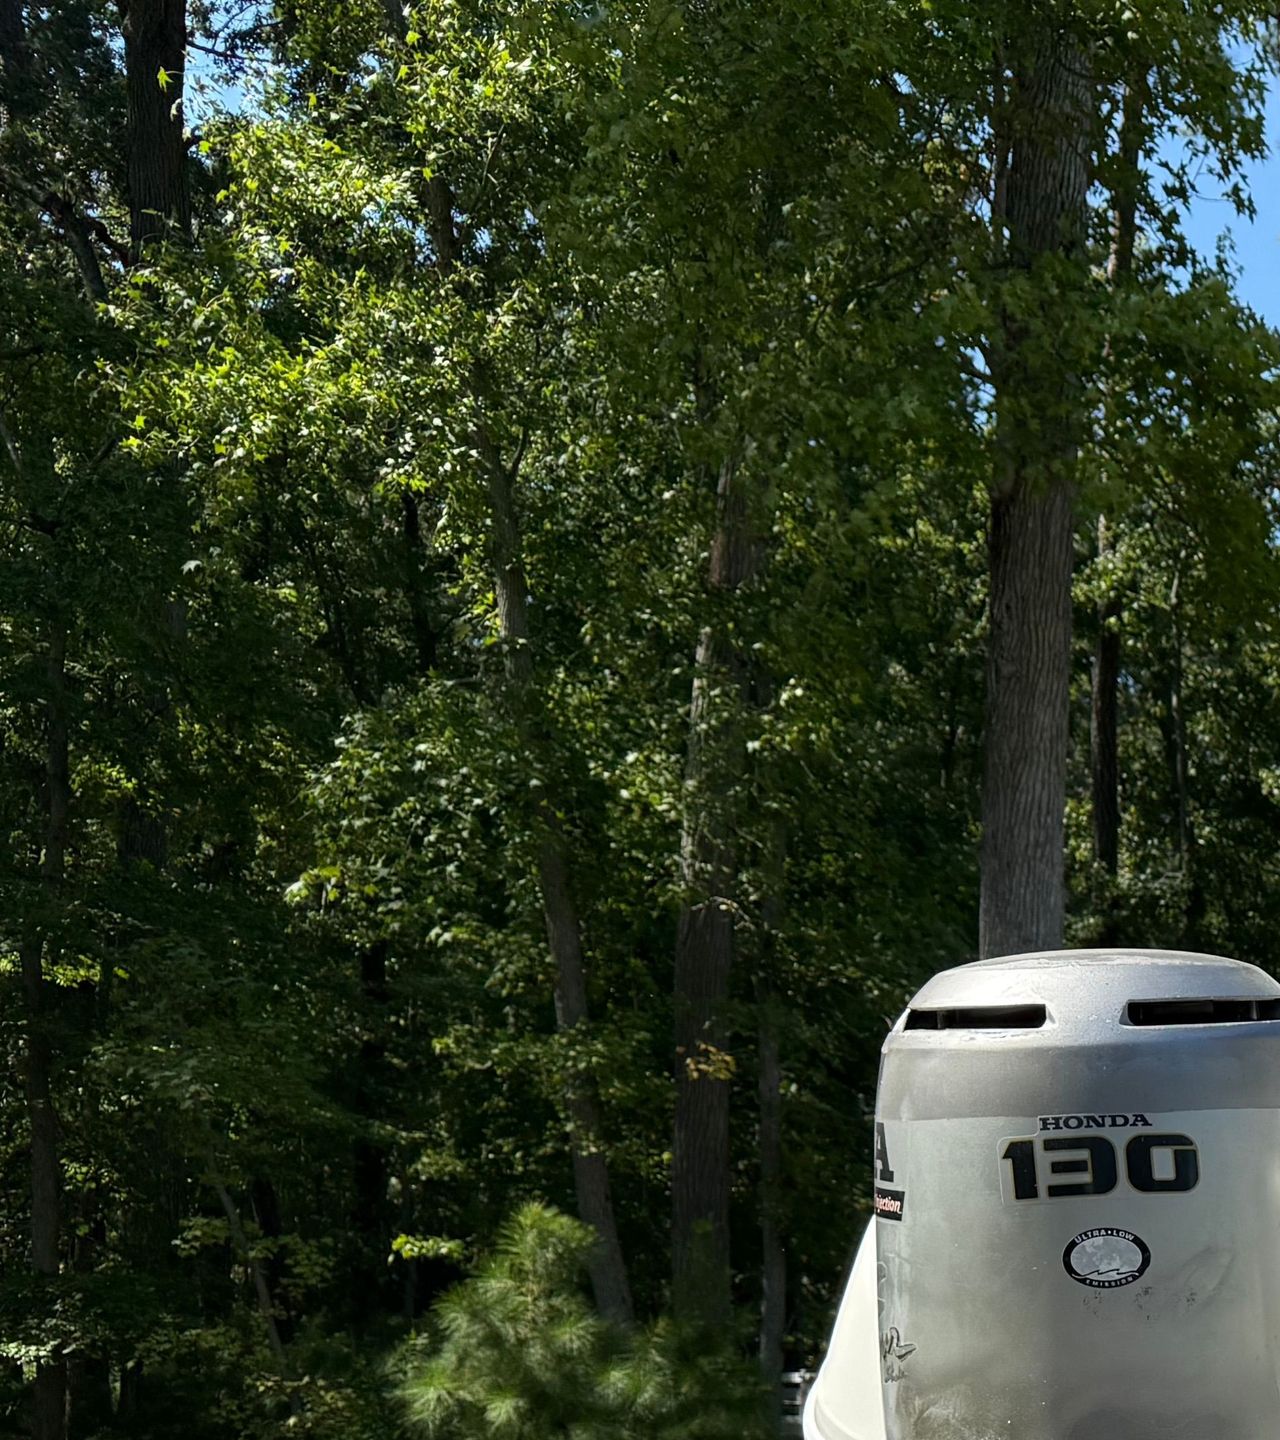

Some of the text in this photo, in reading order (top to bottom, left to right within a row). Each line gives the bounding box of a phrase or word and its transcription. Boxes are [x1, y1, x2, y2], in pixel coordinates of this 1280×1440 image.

[1039, 1113, 1152, 1131] HONDA
[1002, 1134, 1199, 1200] 130
[1086, 1276, 1134, 1287] EMISSION
